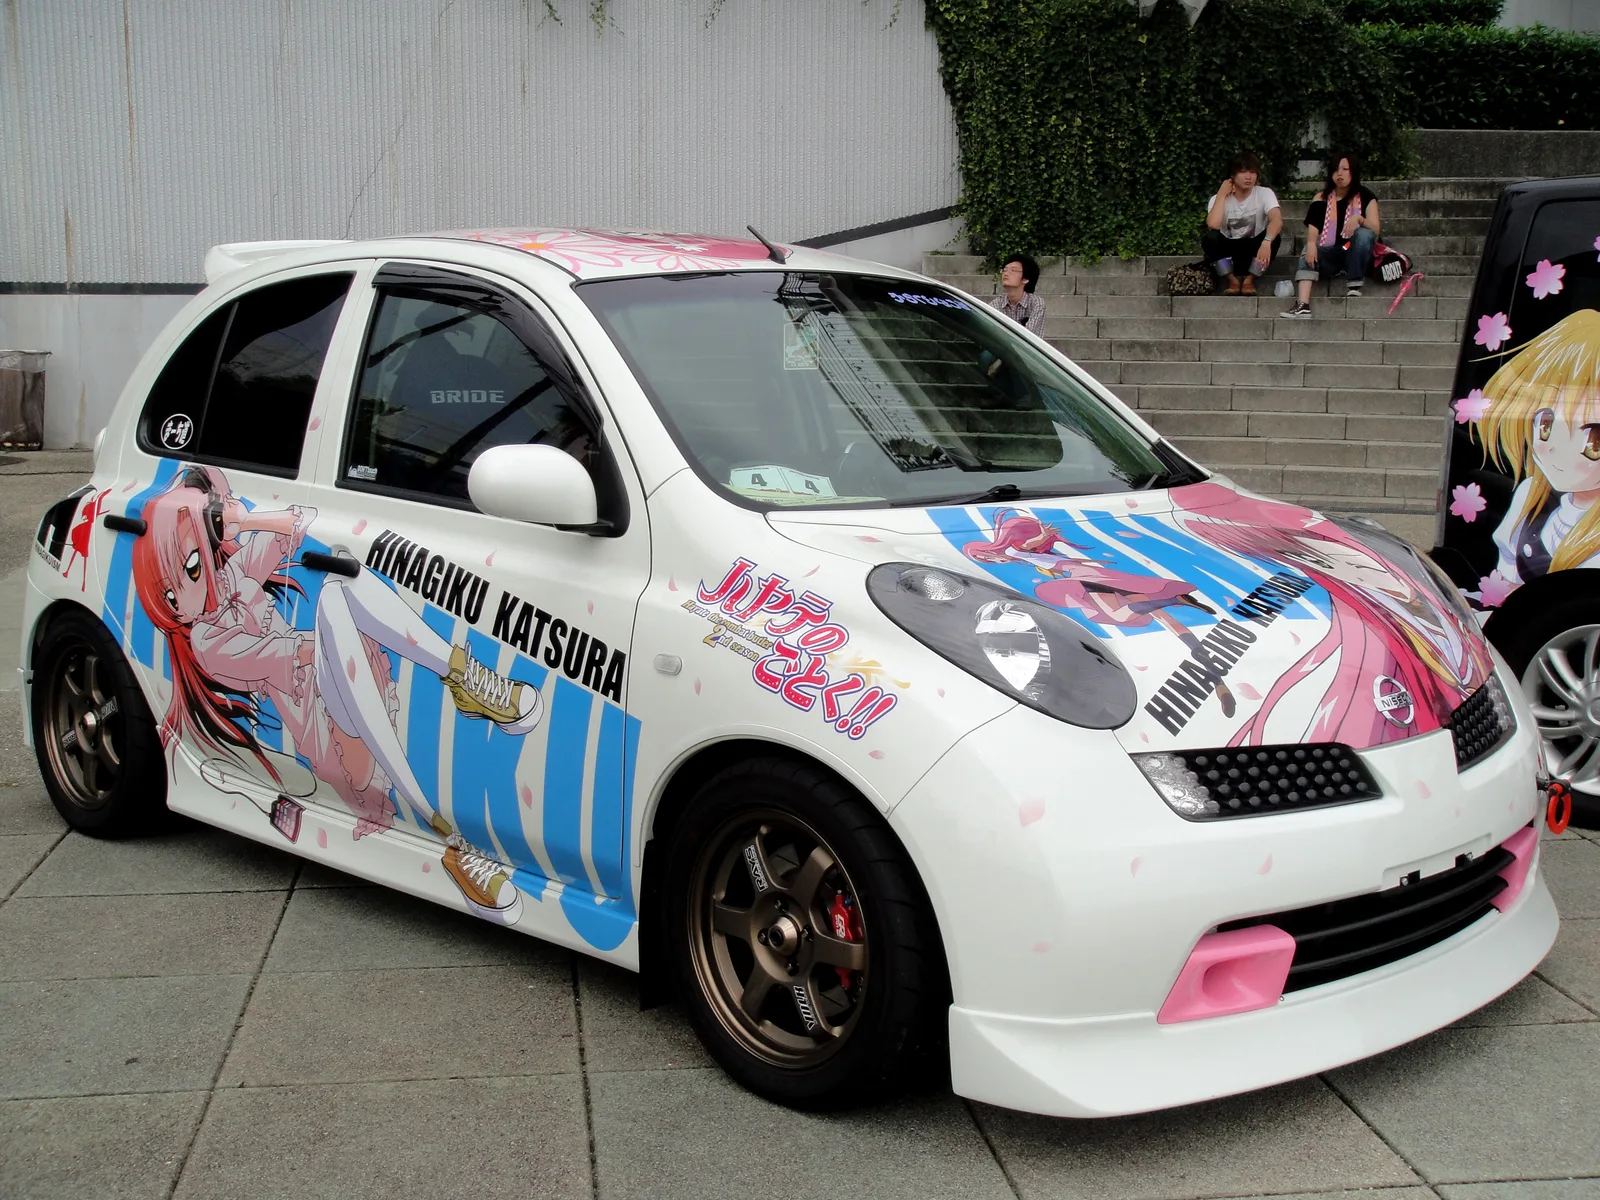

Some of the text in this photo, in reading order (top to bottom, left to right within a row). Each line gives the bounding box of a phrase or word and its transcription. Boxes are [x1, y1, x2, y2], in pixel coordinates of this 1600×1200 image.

[430, 390, 505, 404] BRIDE
[365, 529, 626, 704] HINAGIKU KATSURA
[681, 599, 774, 650] Hayate the combat butler
[696, 556, 849, 655] ハヤテの
[703, 624, 760, 662] 2nd season
[1144, 571, 1316, 737] HINAGIKU KATSURA
[744, 846, 766, 892] RAYS
